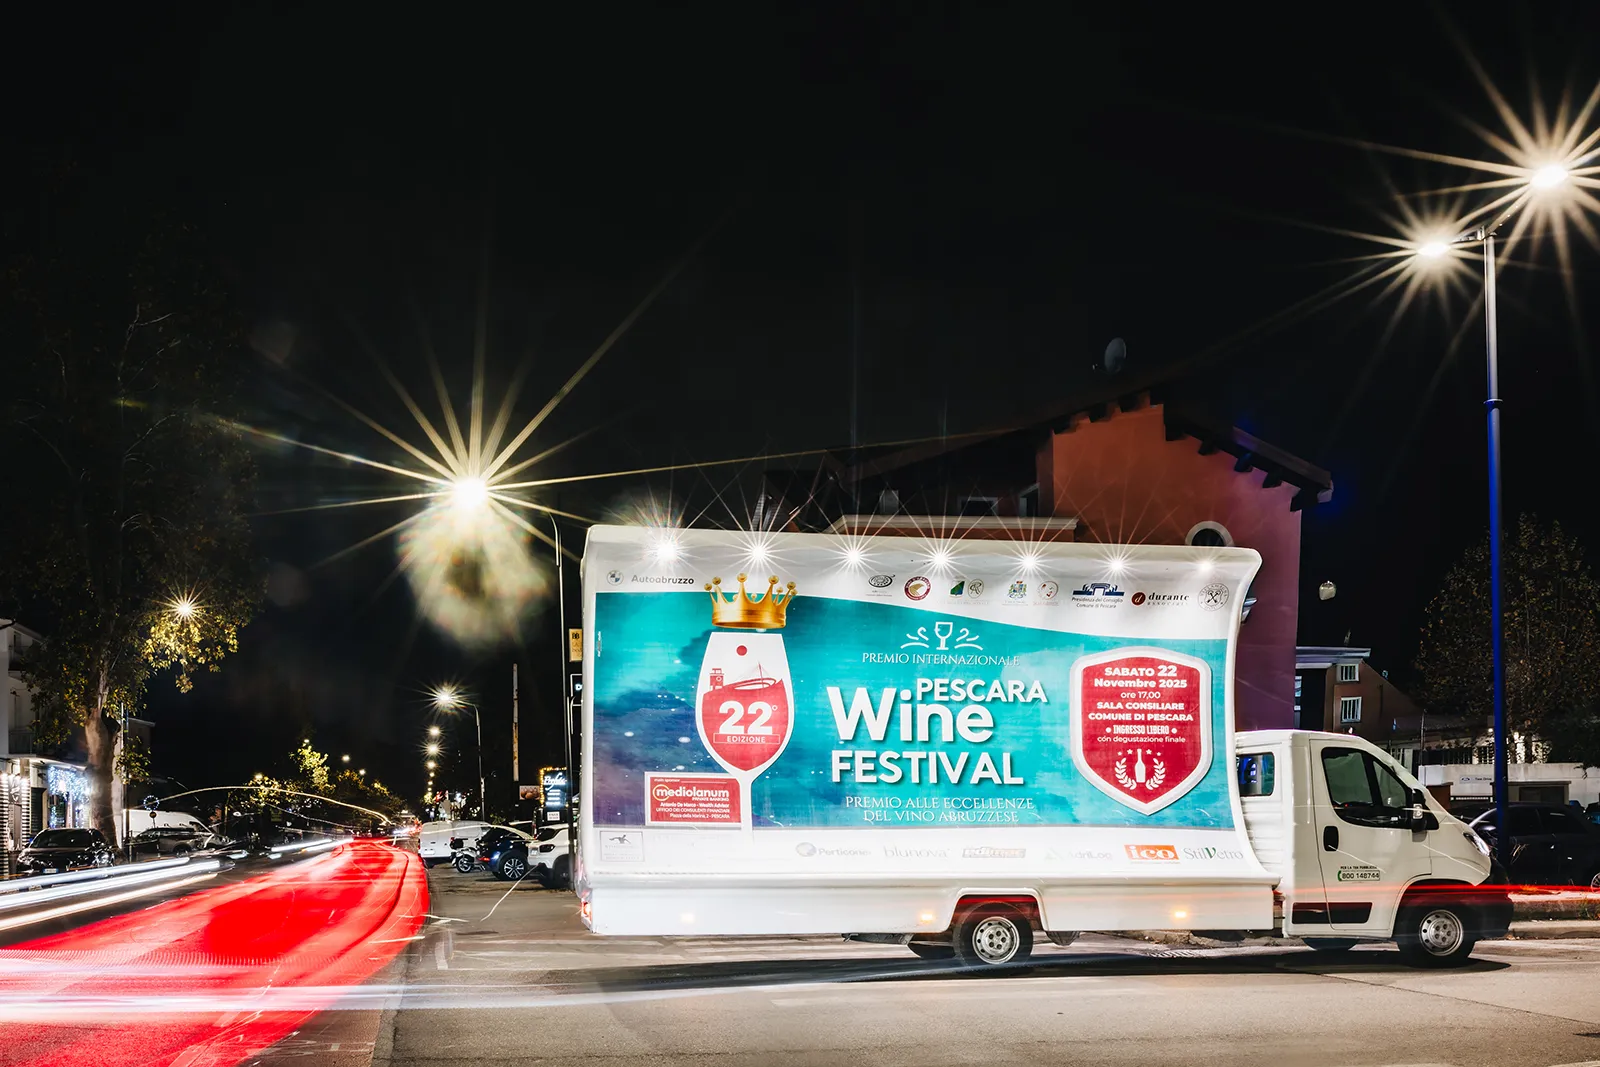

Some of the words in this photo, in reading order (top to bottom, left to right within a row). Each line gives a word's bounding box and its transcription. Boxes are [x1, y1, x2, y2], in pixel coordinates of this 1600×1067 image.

[631, 575, 695, 585] Autoabruzzo
[1148, 592, 1190, 601] durante
[862, 653, 909, 664] PREMIO
[912, 654, 1021, 666] INTERNAZIONALE
[1104, 667, 1155, 677] SABATO
[1157, 665, 1178, 677] 22
[1094, 678, 1156, 688] Novembre
[1158, 679, 1188, 688] 2025
[916, 678, 1048, 703] PESCARA
[1138, 691, 1161, 700] 17,00
[1125, 702, 1185, 710] CONSILIARE
[826, 686, 994, 743] Wine
[1088, 713, 1132, 721] COMUNE
[1134, 713, 1145, 721] DI
[1147, 713, 1194, 721] PESCARA
[1113, 724, 1145, 734] INGRESSO
[1147, 725, 1170, 735] LIBERO
[1113, 735, 1164, 744] degustazione
[831, 750, 1024, 784] FESTIVAL
[656, 786, 729, 797] mediolanum
[845, 796, 901, 808] PREMIO
[905, 798, 940, 809] ALLE
[943, 798, 1035, 810] ECCELLENZE
[863, 810, 892, 824] DEL
[895, 811, 935, 822] VINO
[938, 811, 1019, 823] ABRUZZESE
[1128, 845, 1176, 860] ico
[1183, 847, 1244, 860] StilVetro
